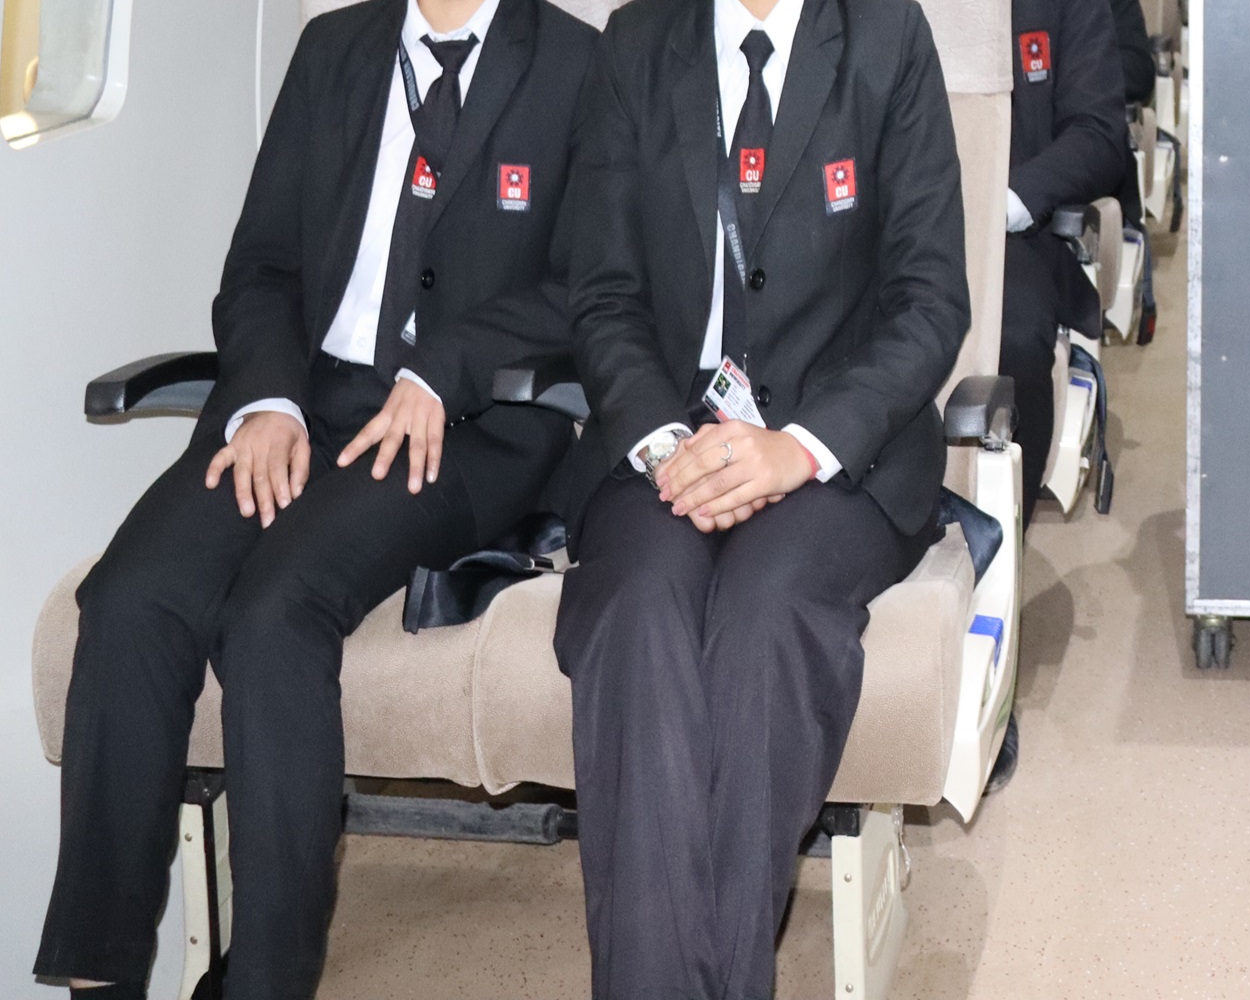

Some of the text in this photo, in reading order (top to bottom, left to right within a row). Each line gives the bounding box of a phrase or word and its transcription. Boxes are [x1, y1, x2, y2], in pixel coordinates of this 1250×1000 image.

[1030, 59, 1043, 71] CU
[746, 169, 760, 181] CU
[418, 176, 433, 188] CU
[507, 187, 522, 199] CU
[836, 185, 849, 198] CU
[727, 223, 746, 286] CHANDIGA
